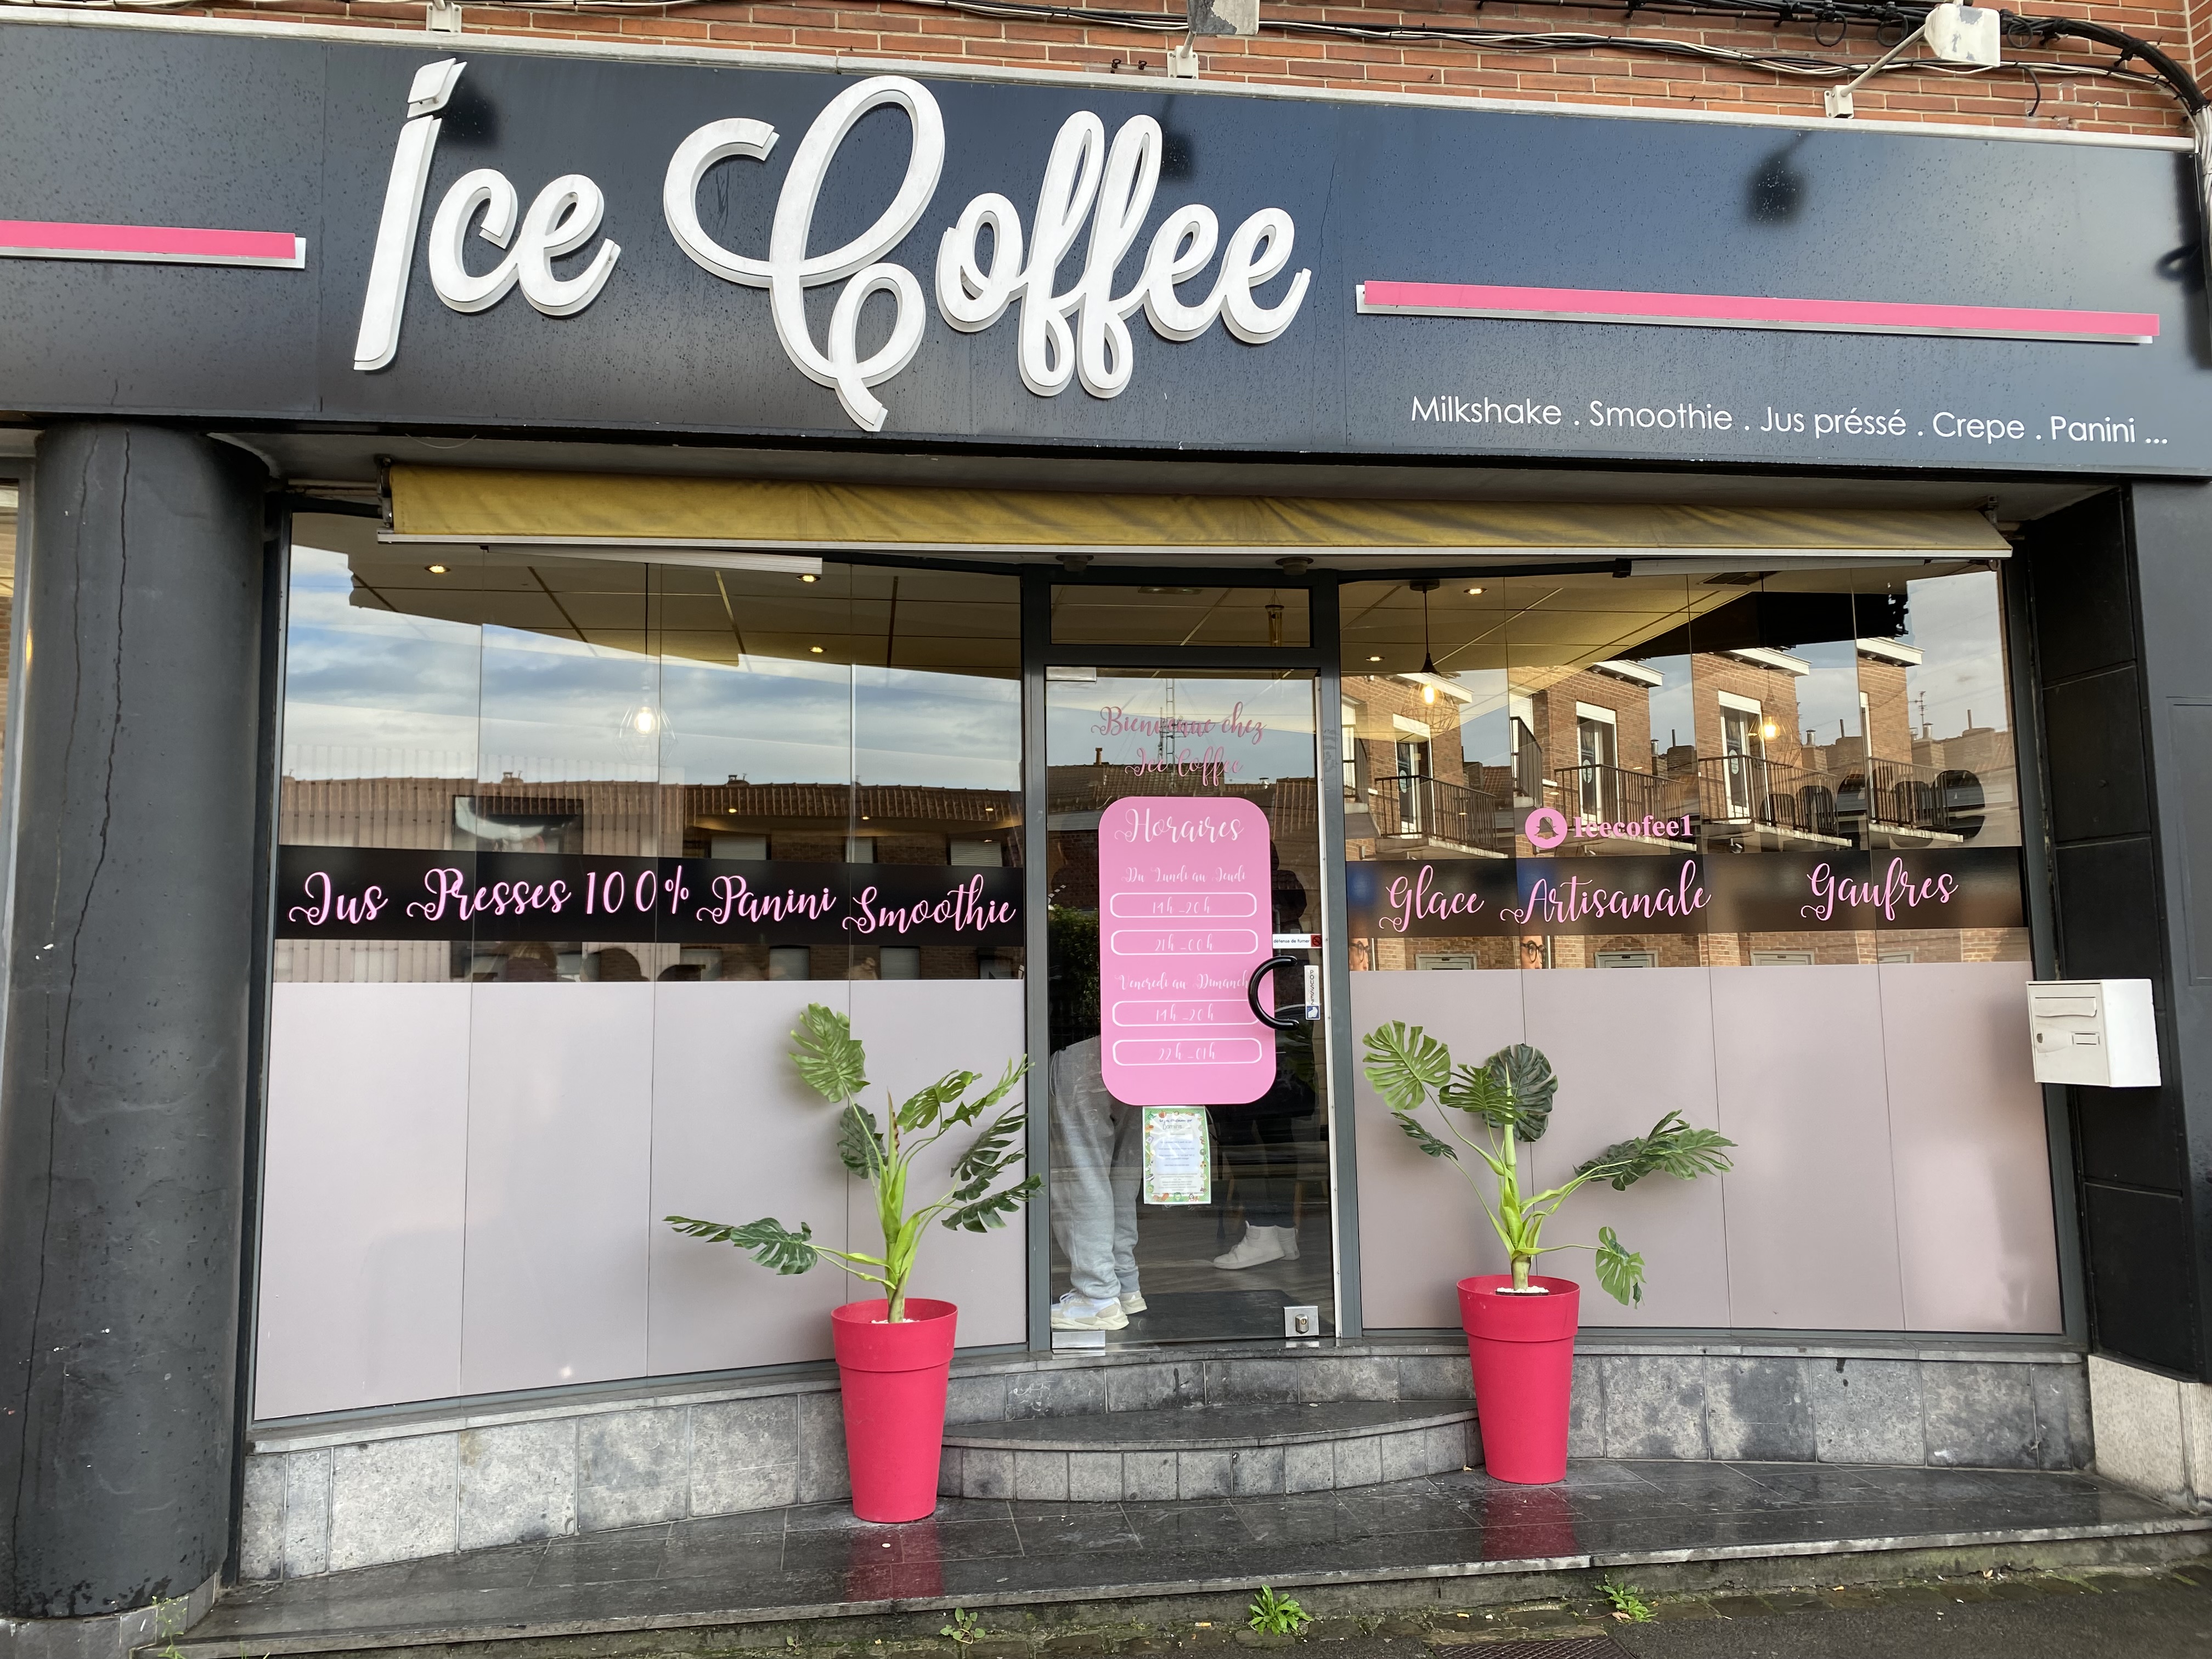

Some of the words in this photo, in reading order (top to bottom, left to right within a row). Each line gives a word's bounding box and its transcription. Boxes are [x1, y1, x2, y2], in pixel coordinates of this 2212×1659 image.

[353, 58, 620, 372] Ice
[663, 76, 1312, 432] Coffee
[1411, 395, 1562, 425] Milkshake
[1589, 400, 1733, 430] Smoothie
[1760, 407, 1805, 432] Jus
[1814, 407, 1906, 439] préssé
[1932, 411, 2025, 444] Crepe
[2050, 416, 2136, 443] Panini
[1091, 707, 1216, 737] Bienvenue
[1222, 702, 1267, 744] chez
[1125, 747, 1168, 776] Ice
[1175, 746, 1243, 786] Coffee
[1114, 808, 1244, 843] Horaires
[1121, 867, 1145, 883] Du
[1150, 865, 1188, 883] Lundi
[1192, 872, 1207, 883] au
[1212, 865, 1246, 883] Jeudi
[1379, 865, 1485, 933] Glace
[1500, 859, 1712, 924] Artisanale
[1801, 857, 1958, 921] Gaufres
[289, 871, 388, 926] Jus
[407, 868, 571, 921] Presses
[696, 875, 837, 925] Panini
[842, 874, 1016, 933] Smoothie
[1172, 979, 1187, 990] au
[1195, 970, 1250, 990] Dimanch
